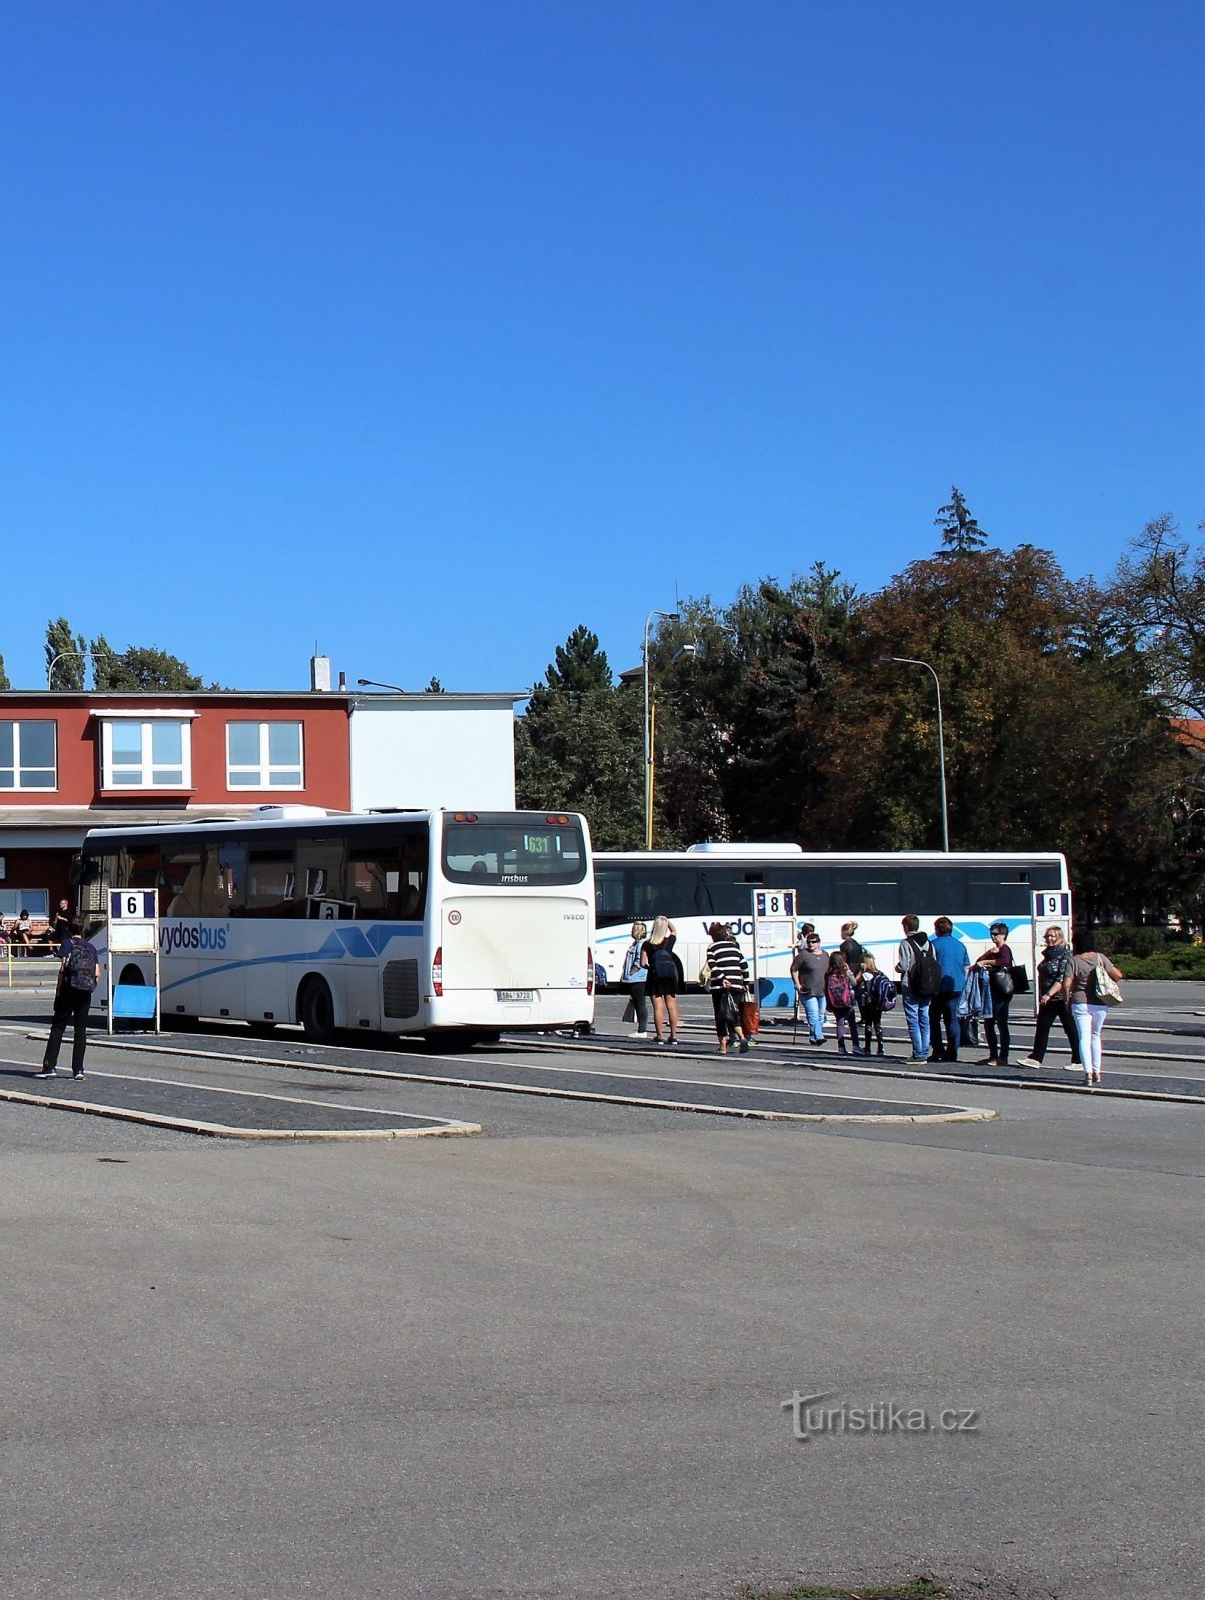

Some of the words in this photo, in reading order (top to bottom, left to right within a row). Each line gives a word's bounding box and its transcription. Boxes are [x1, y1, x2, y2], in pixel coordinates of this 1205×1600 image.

[529, 836, 548, 852] 631
[127, 896, 136, 914] 6
[770, 896, 778, 912] 8
[1049, 898, 1056, 912] 9
[159, 922, 226, 954] vydosbus
